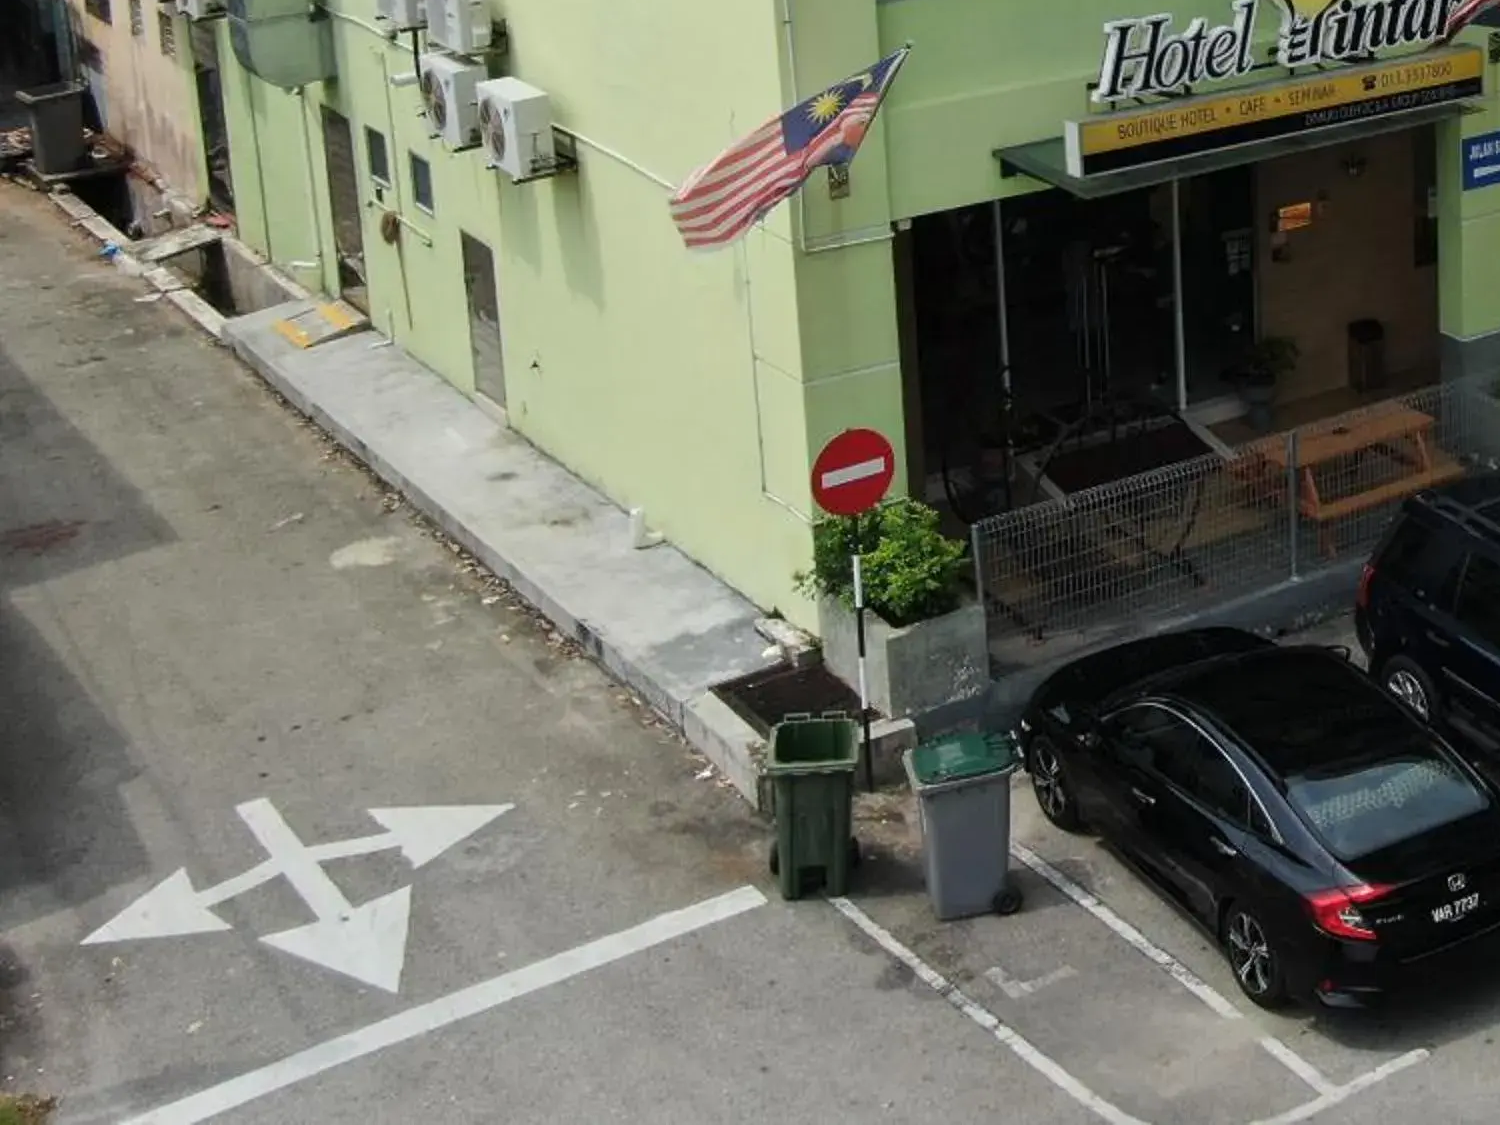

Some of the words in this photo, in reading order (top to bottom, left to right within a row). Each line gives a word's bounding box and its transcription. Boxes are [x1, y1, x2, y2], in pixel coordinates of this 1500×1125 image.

[1117, 113, 1177, 140] BOUTIQUE
[1180, 108, 1217, 128] HOTEL
[1239, 96, 1265, 116] CAFE
[1287, 83, 1337, 106] SEMINAR
[1469, 139, 1494, 161] JALAN
